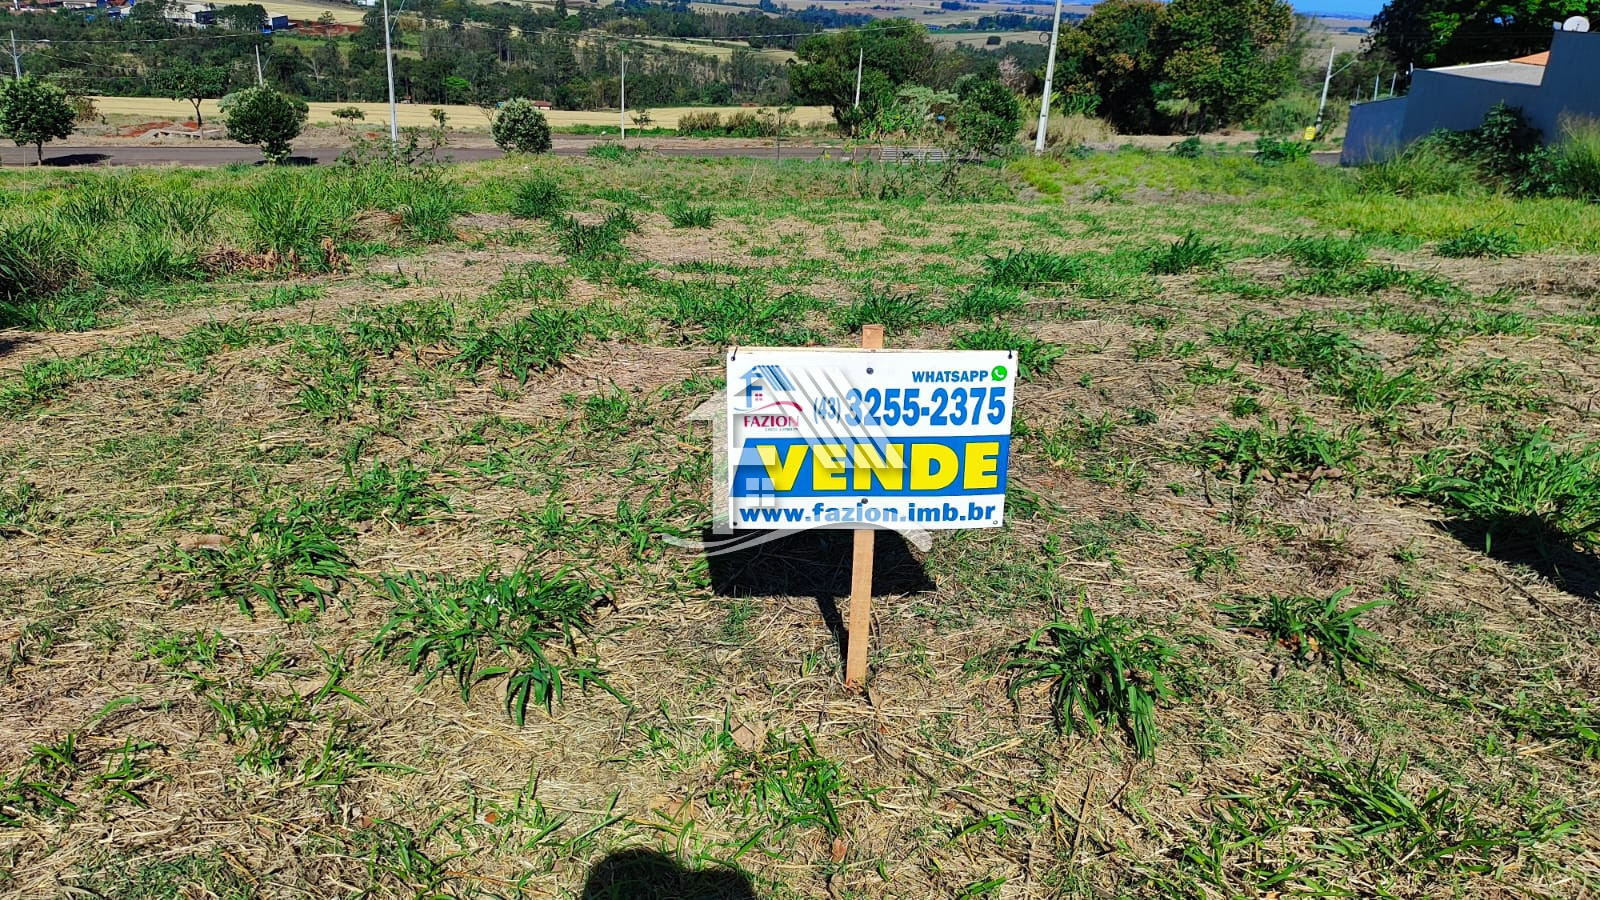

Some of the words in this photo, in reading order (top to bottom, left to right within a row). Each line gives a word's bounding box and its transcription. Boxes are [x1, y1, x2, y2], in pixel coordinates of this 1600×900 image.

[912, 370, 988, 382] WHATSAPP
[813, 396, 841, 425] (43)
[845, 386, 1006, 426] 3255-2375
[743, 415, 799, 427] FAZION
[756, 441, 1000, 491] VENDE
[739, 502, 996, 523] www.fazion.imb.br
